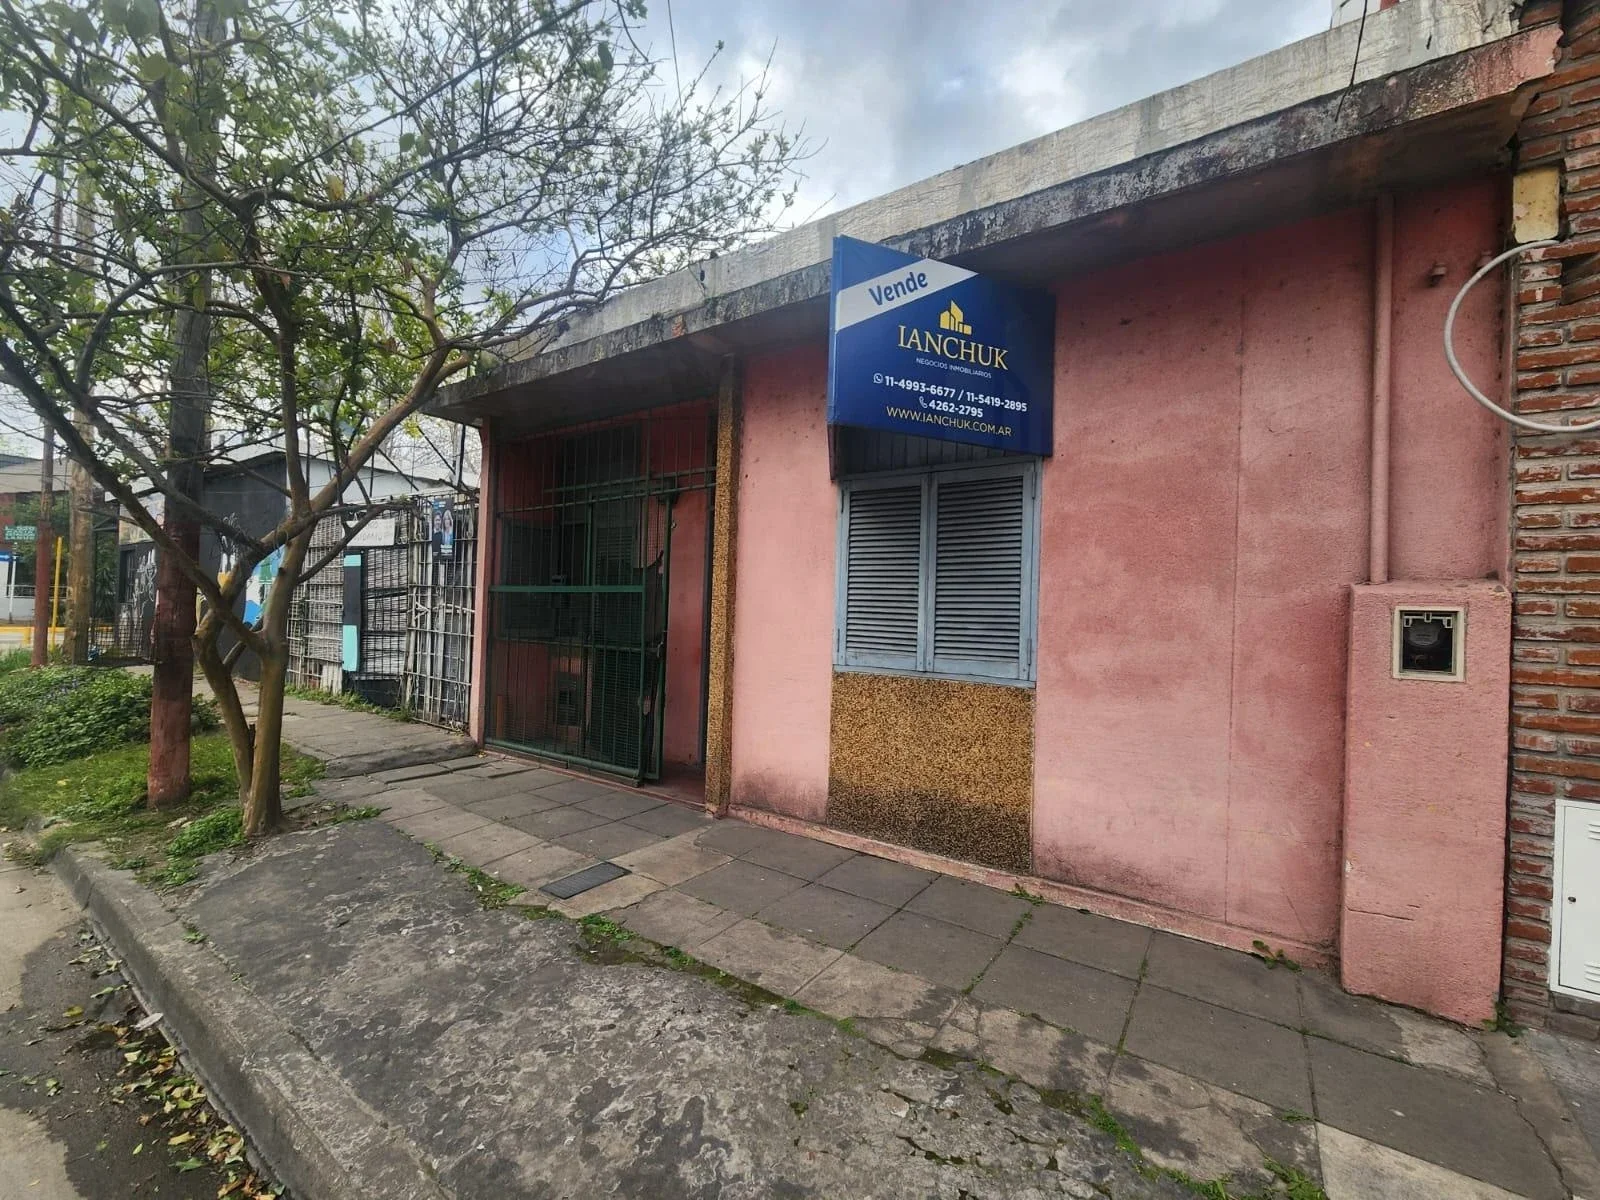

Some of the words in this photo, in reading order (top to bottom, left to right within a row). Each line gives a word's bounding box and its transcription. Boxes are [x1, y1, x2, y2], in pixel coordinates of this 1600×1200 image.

[868, 271, 928, 306] Vende
[898, 325, 1009, 371] IANCHUK
[915, 357, 949, 371] NEGOCIOS
[948, 364, 993, 379] INMOBILIARIOS
[884, 375, 956, 399] 11-4993-6677
[966, 391, 1028, 412] 11-5419-2895
[928, 399, 984, 418] 4262-2795
[886, 406, 1012, 437] WWW.IANCHUK.COM.AR
